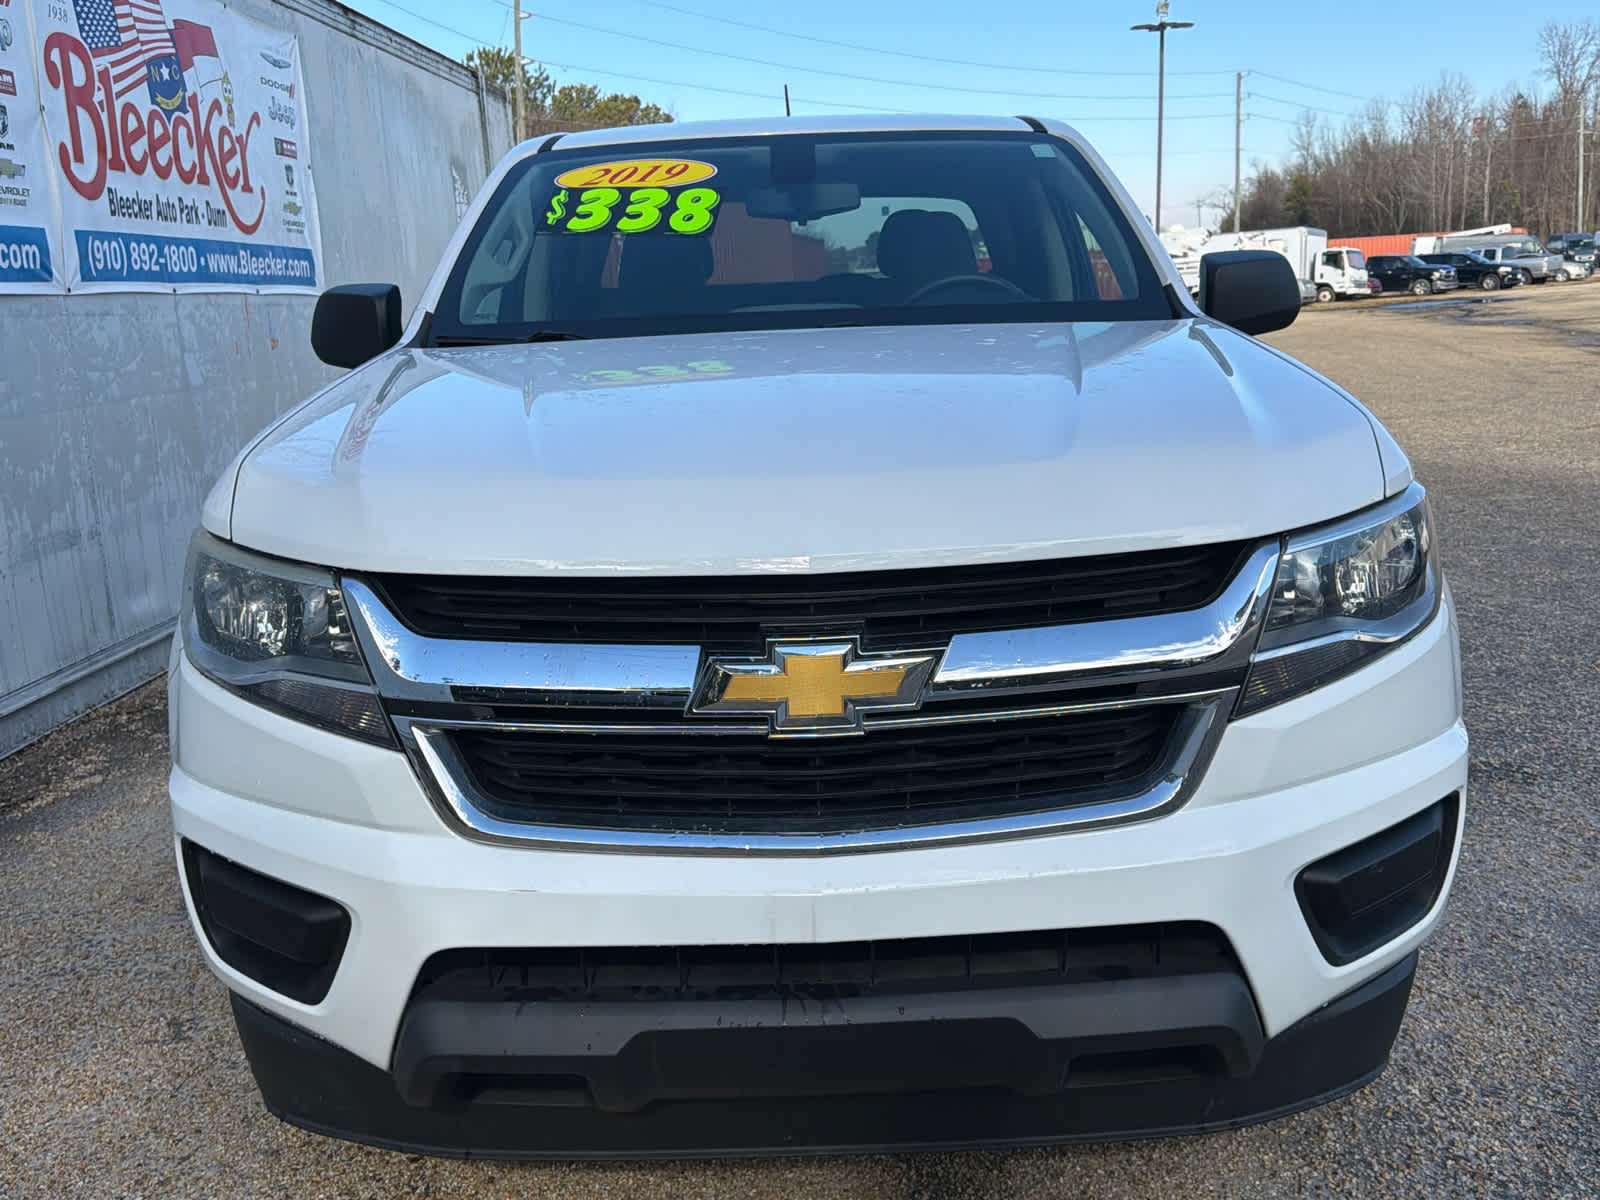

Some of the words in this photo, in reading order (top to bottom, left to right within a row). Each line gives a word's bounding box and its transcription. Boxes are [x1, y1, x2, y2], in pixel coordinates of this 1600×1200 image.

[48, 4, 68, 24] 1938
[44, 32, 266, 235] Bleecker
[579, 163, 690, 187] 2019
[107, 186, 153, 220] Bleecker
[156, 193, 177, 223] Auto
[178, 196, 201, 225] Park
[206, 200, 228, 229] Dunn
[546, 187, 721, 235] $338
[87, 235, 128, 277] (910)
[130, 242, 198, 273] 892-1800
[207, 249, 311, 279] www.Bleecker.com
